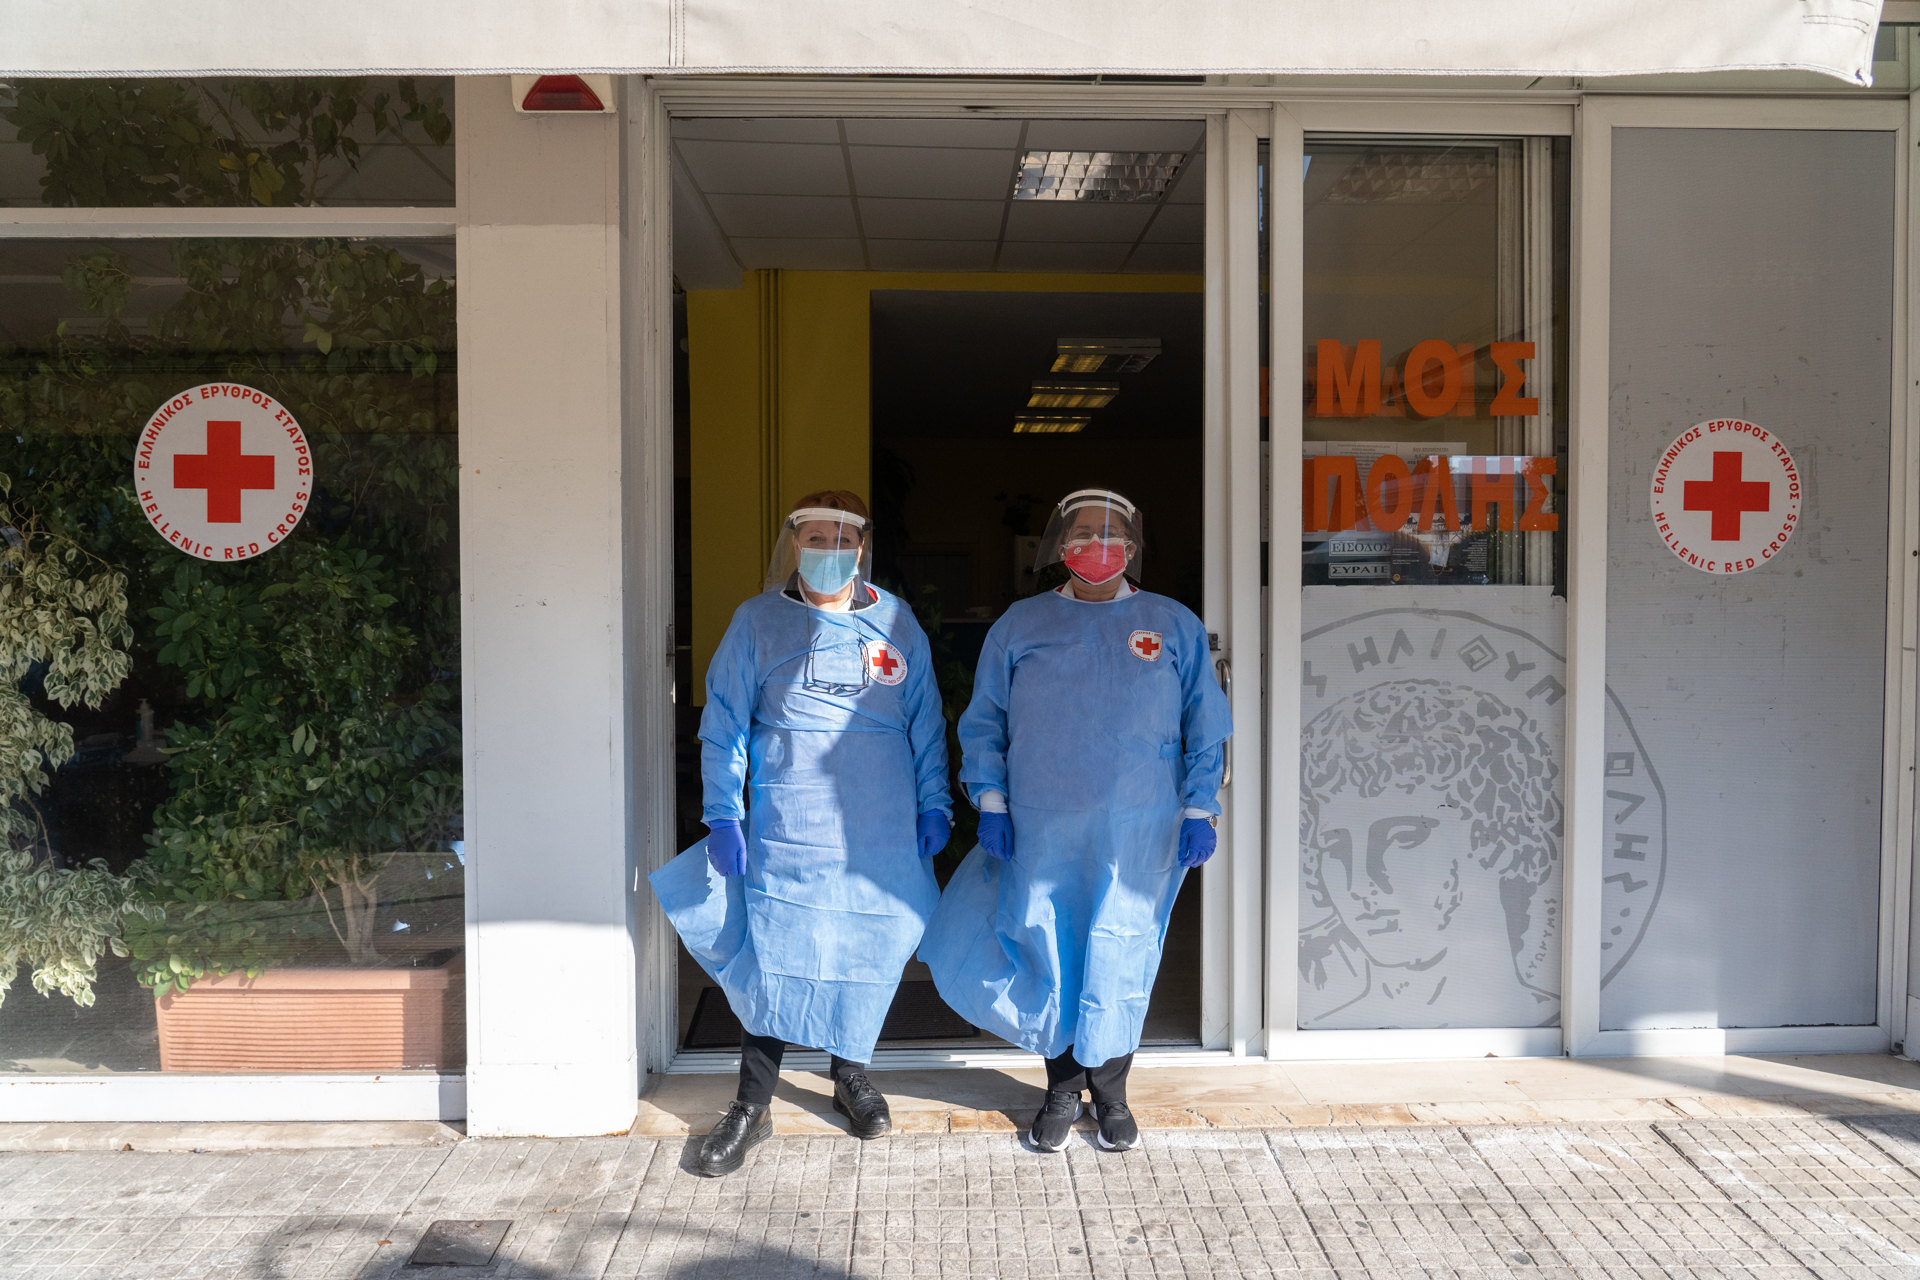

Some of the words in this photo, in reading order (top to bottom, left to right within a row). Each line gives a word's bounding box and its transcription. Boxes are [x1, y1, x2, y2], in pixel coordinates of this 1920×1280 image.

[138, 394, 193, 469] ΕΛΛΗΝΙΚΟΣ
[200, 385, 273, 410] ΕΡΥΘΡΟΣ
[275, 409, 310, 476] ΣΤΑΥΡΟΣ
[1654, 427, 1702, 494] ΕΛΛΗΝΙΚΟΣ
[1708, 420, 1769, 442] ΕΡΥΘΡΟΣ
[1771, 442, 1799, 500] ΣΤΑΥΡΟΣ
[140, 490, 213, 557] HELLENIC
[224, 542, 259, 559] RED
[267, 491, 308, 544] CROSS
[1313, 454, 1559, 532] ΠΟΛΗΣ
[1332, 542, 1391, 552] ΕΙΣΟΔΟΣ
[1332, 565, 1388, 574] ΣΥΡΑΤΕ
[1655, 512, 1715, 571] HELLENIC
[1725, 557, 1755, 572] RED
[1761, 513, 1797, 559] CROSS
